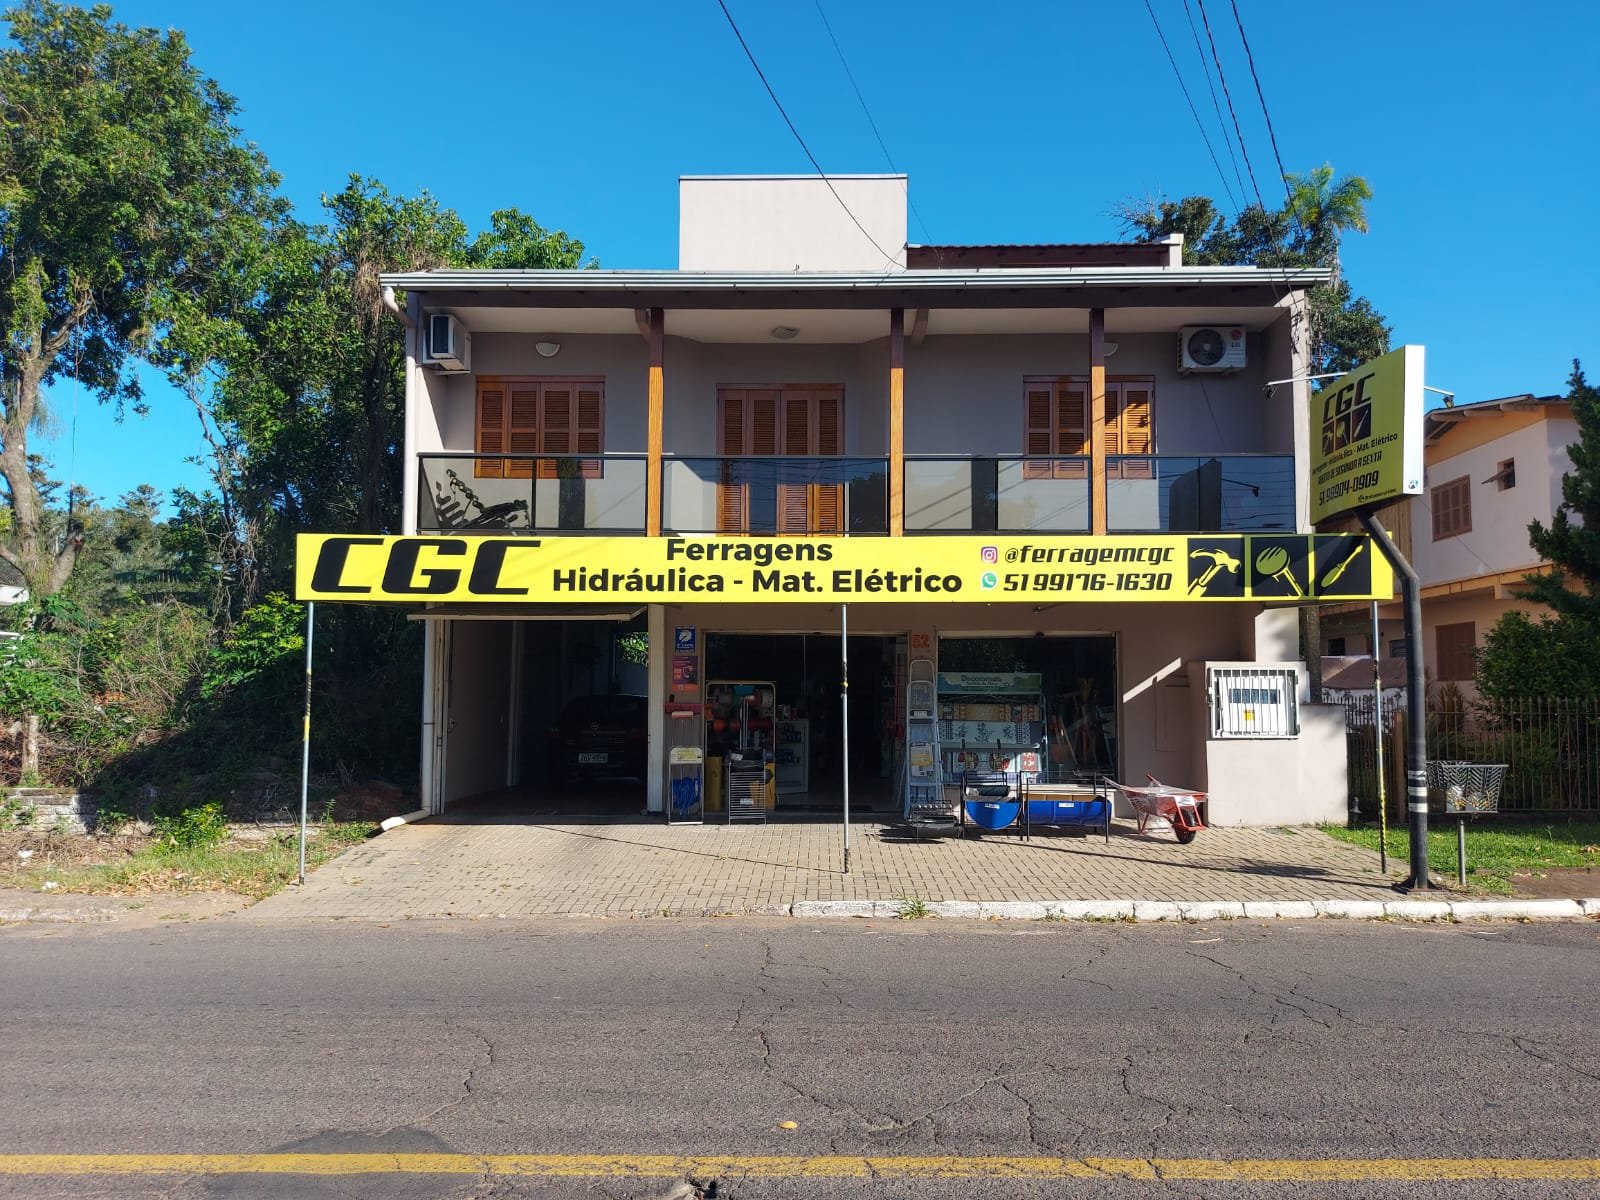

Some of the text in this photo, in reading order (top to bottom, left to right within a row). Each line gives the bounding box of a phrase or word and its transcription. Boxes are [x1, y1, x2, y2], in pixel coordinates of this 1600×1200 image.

[1323, 373, 1375, 424] CGC
[1371, 433, 1398, 448] Elétrico
[667, 538, 833, 566] Ferragens
[1005, 545, 1175, 566] @ferragemcgc
[311, 537, 541, 595] CGC
[553, 567, 724, 592] Hidráulica
[752, 570, 824, 593] Mat.
[832, 568, 962, 593] Elétrico
[1003, 573, 1173, 591] 51 99176-1630
